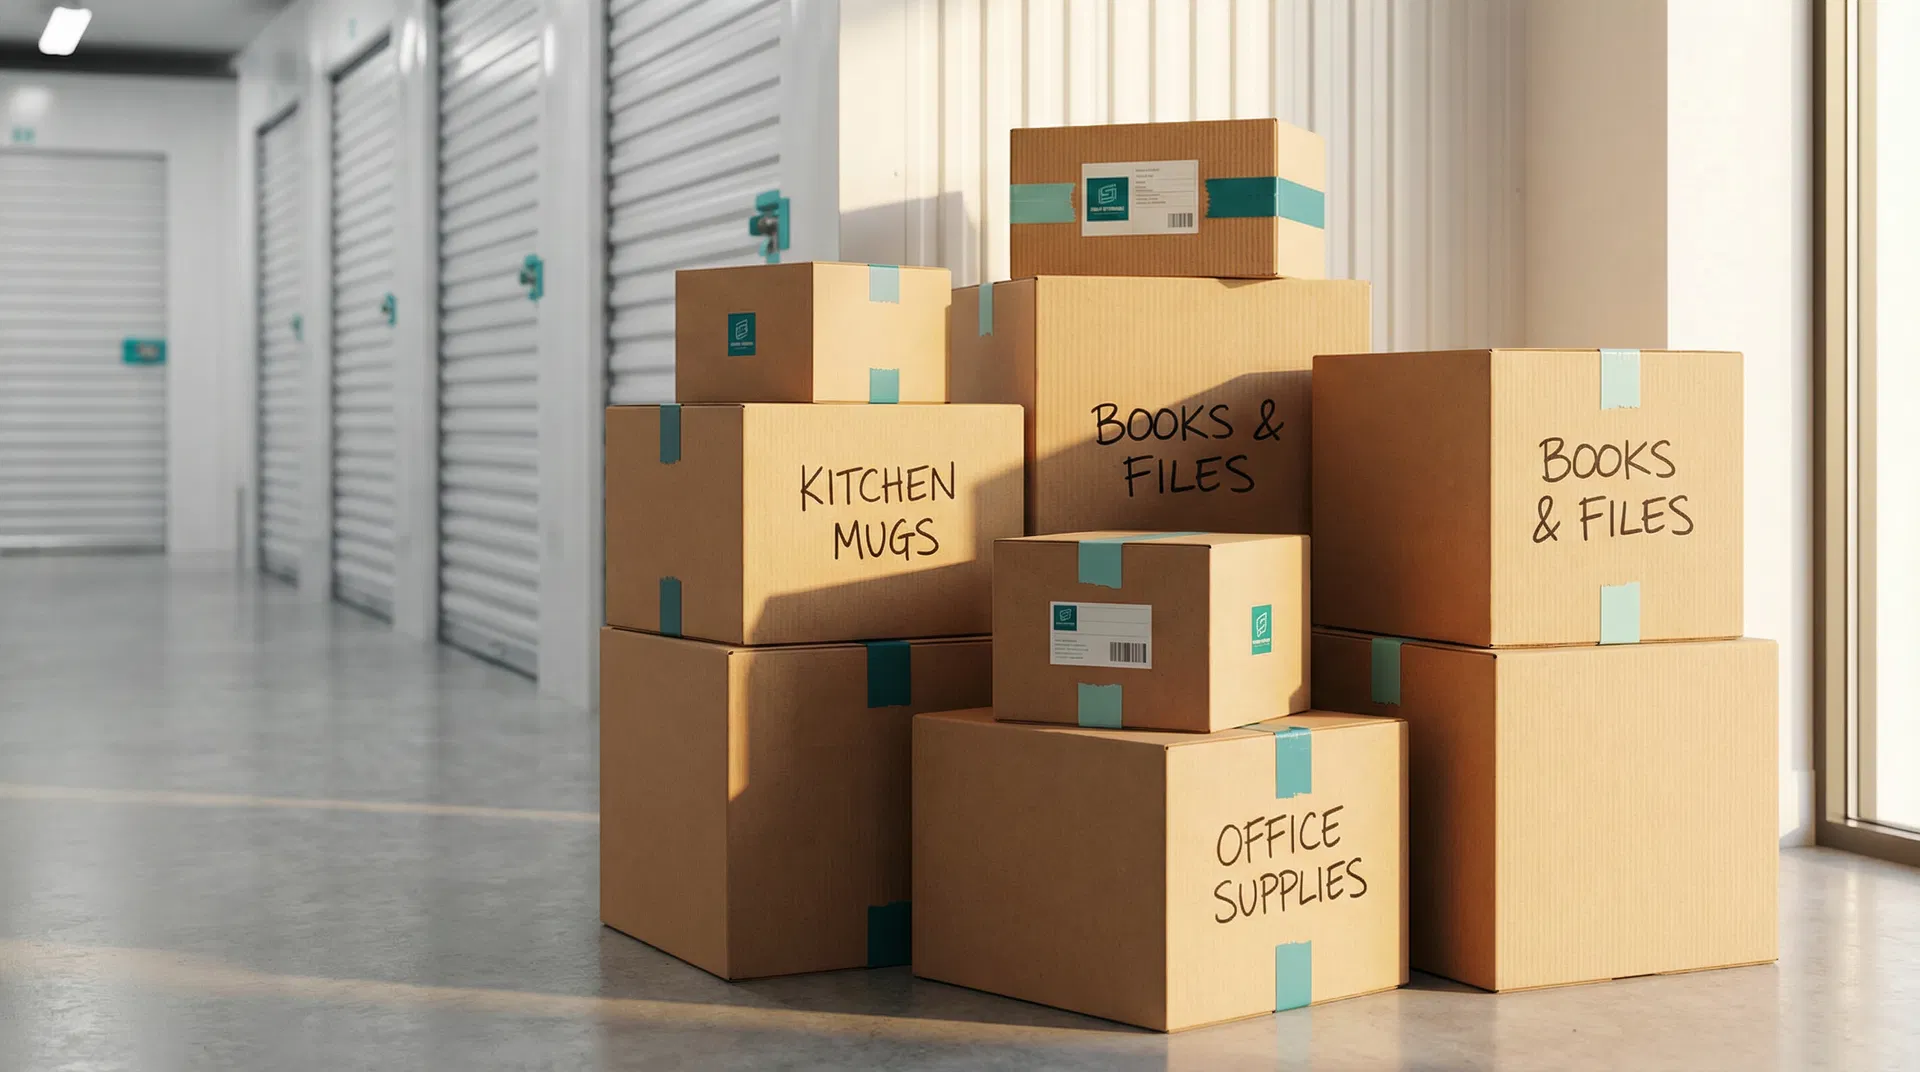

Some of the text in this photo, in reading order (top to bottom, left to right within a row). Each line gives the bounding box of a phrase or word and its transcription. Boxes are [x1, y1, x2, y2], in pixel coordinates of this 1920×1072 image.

[1091, 399, 1285, 445] BOOKS &
[1124, 455, 1256, 497] FILES
[1539, 437, 1675, 483] BOOKS
[800, 462, 955, 511] KITCHEN
[834, 519, 939, 561] MUGS
[1532, 495, 1694, 543] & FILES
[1216, 805, 1345, 866] OFFICE
[1214, 857, 1368, 923] SUPPLIES
